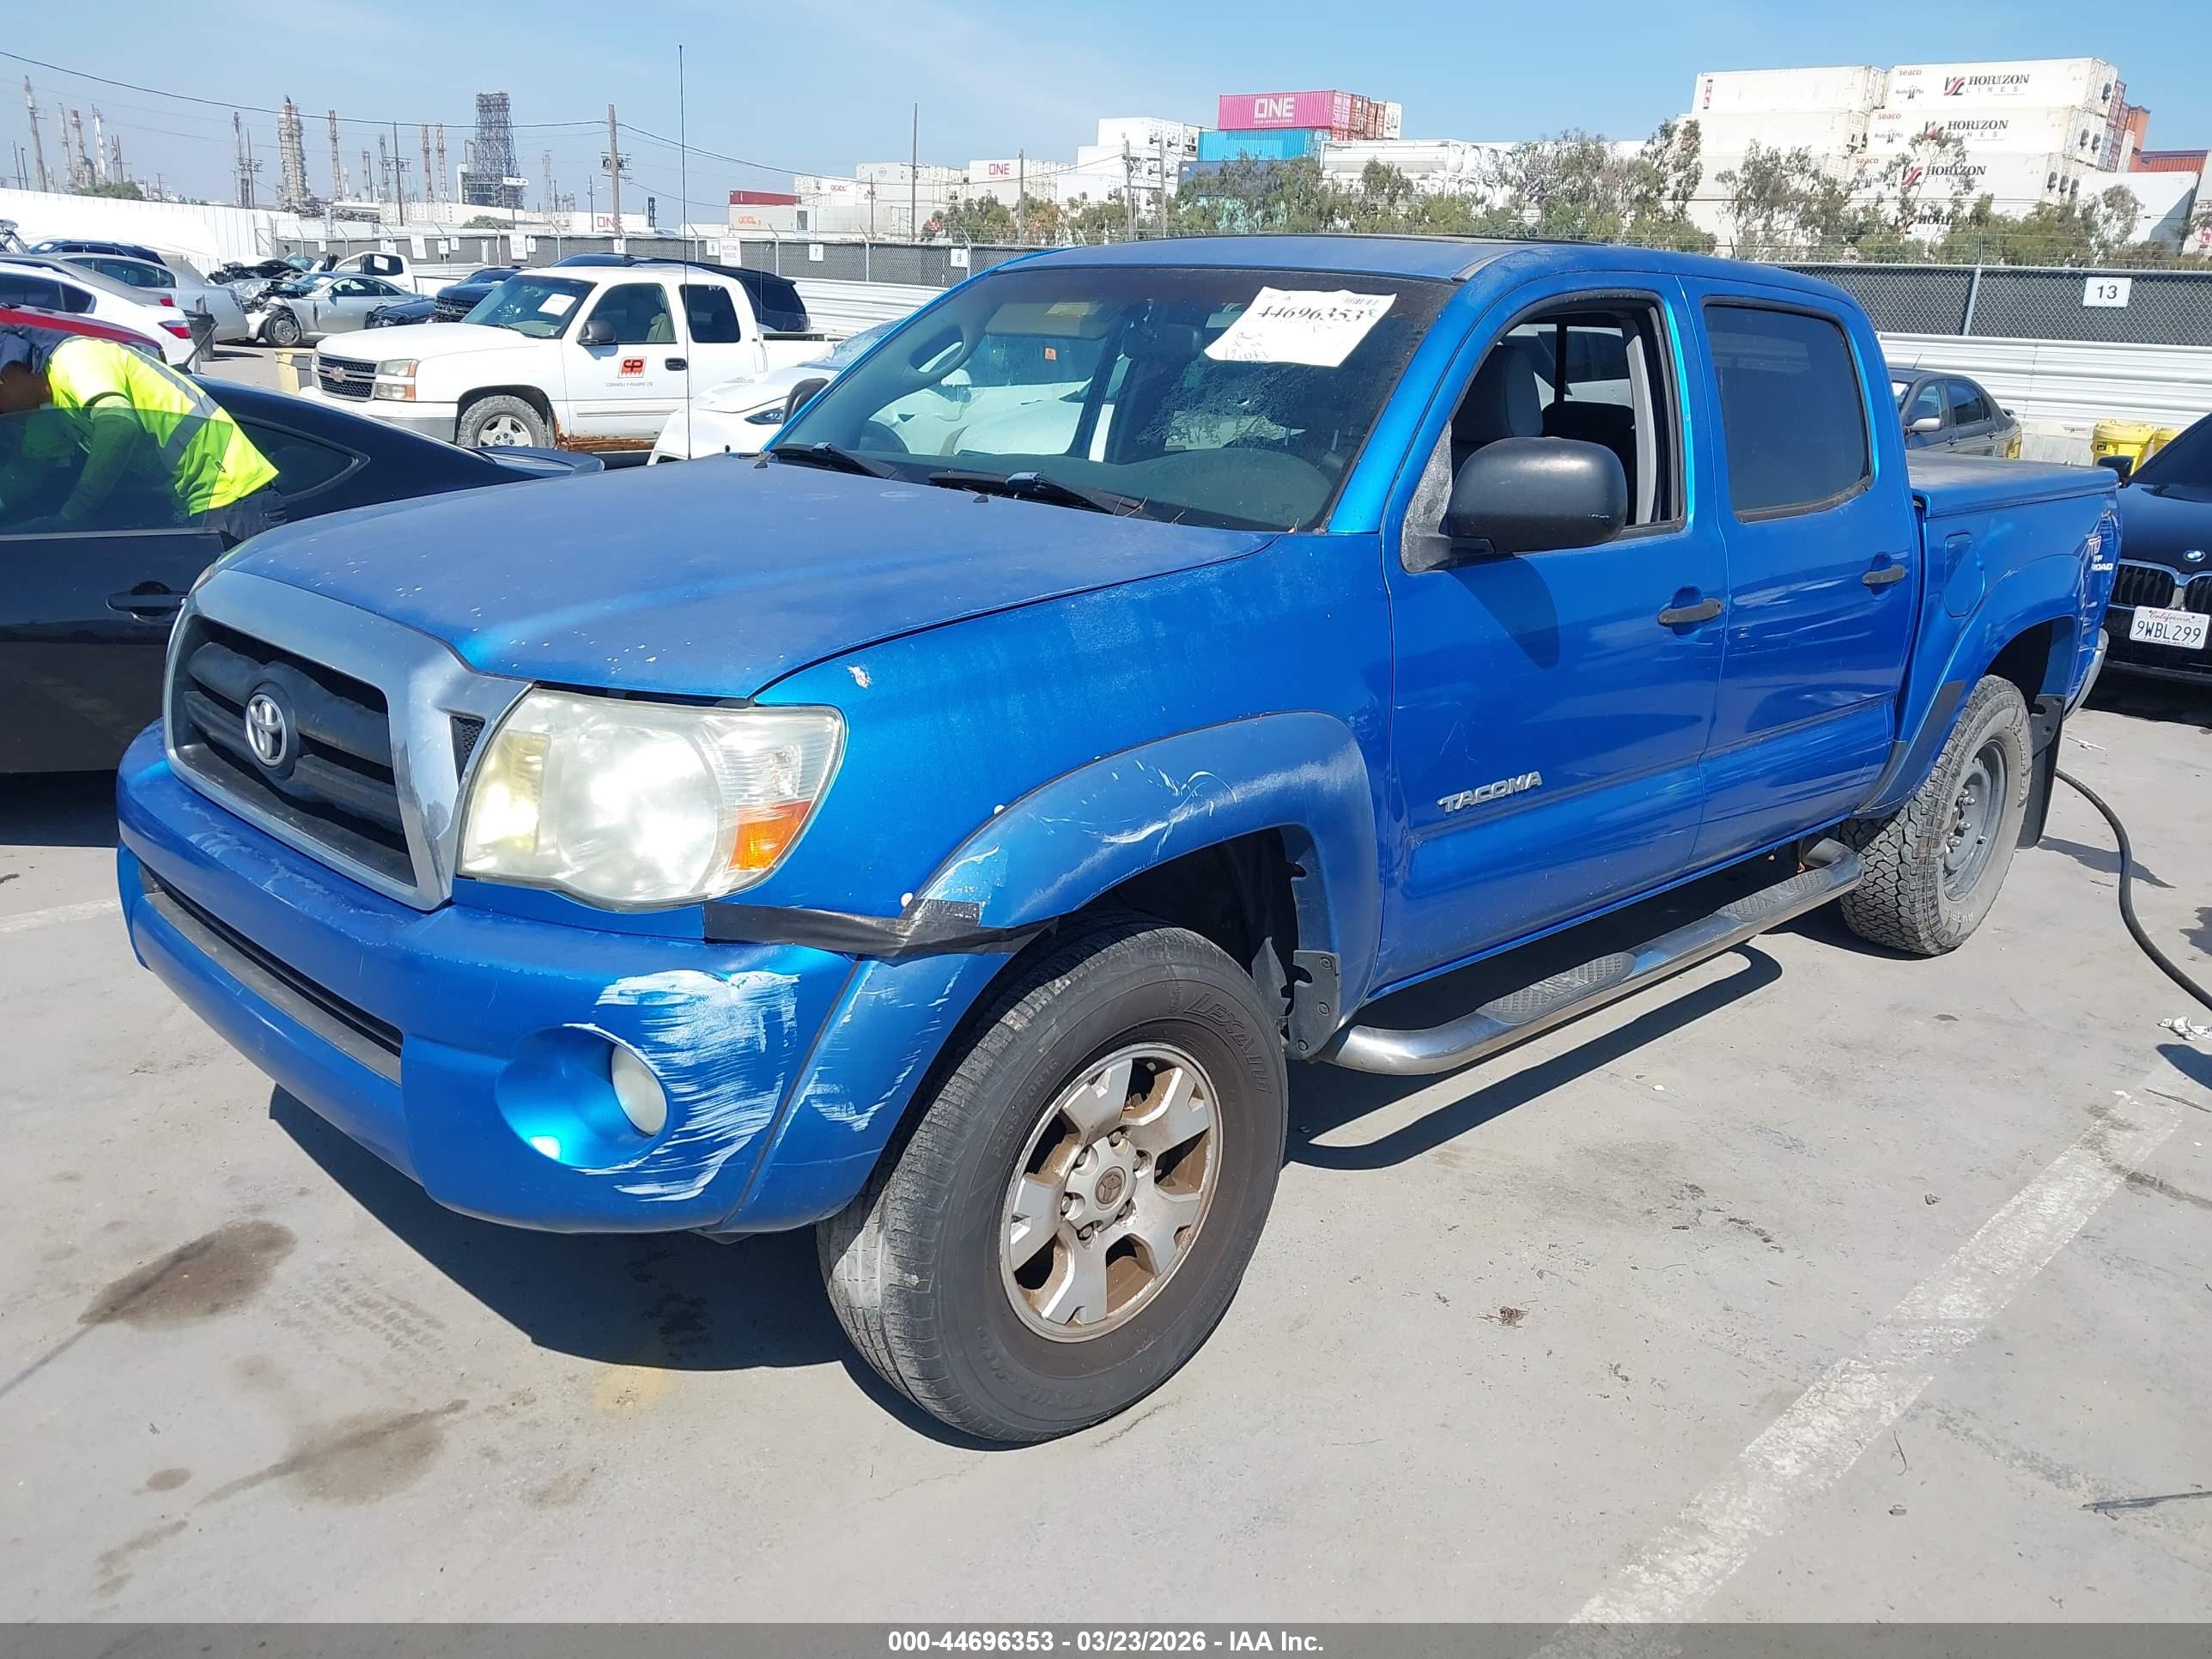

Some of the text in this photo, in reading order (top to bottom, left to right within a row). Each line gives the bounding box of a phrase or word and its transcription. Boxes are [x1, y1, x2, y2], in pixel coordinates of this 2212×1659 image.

[1968, 74, 2030, 86] HORIZON
[1254, 97, 1295, 118] ONE
[1948, 119, 2008, 130] HORIZON
[989, 163, 1010, 174] ONE
[1926, 166, 1986, 176] HORIZON
[957, 253, 962, 262] 8
[2097, 285, 2118, 299] 13
[1257, 305, 1364, 322] 44696353
[2149, 611, 2193, 623] California
[2136, 620, 2202, 643] 9WBL299
[1437, 770, 1543, 812] TACOMA
